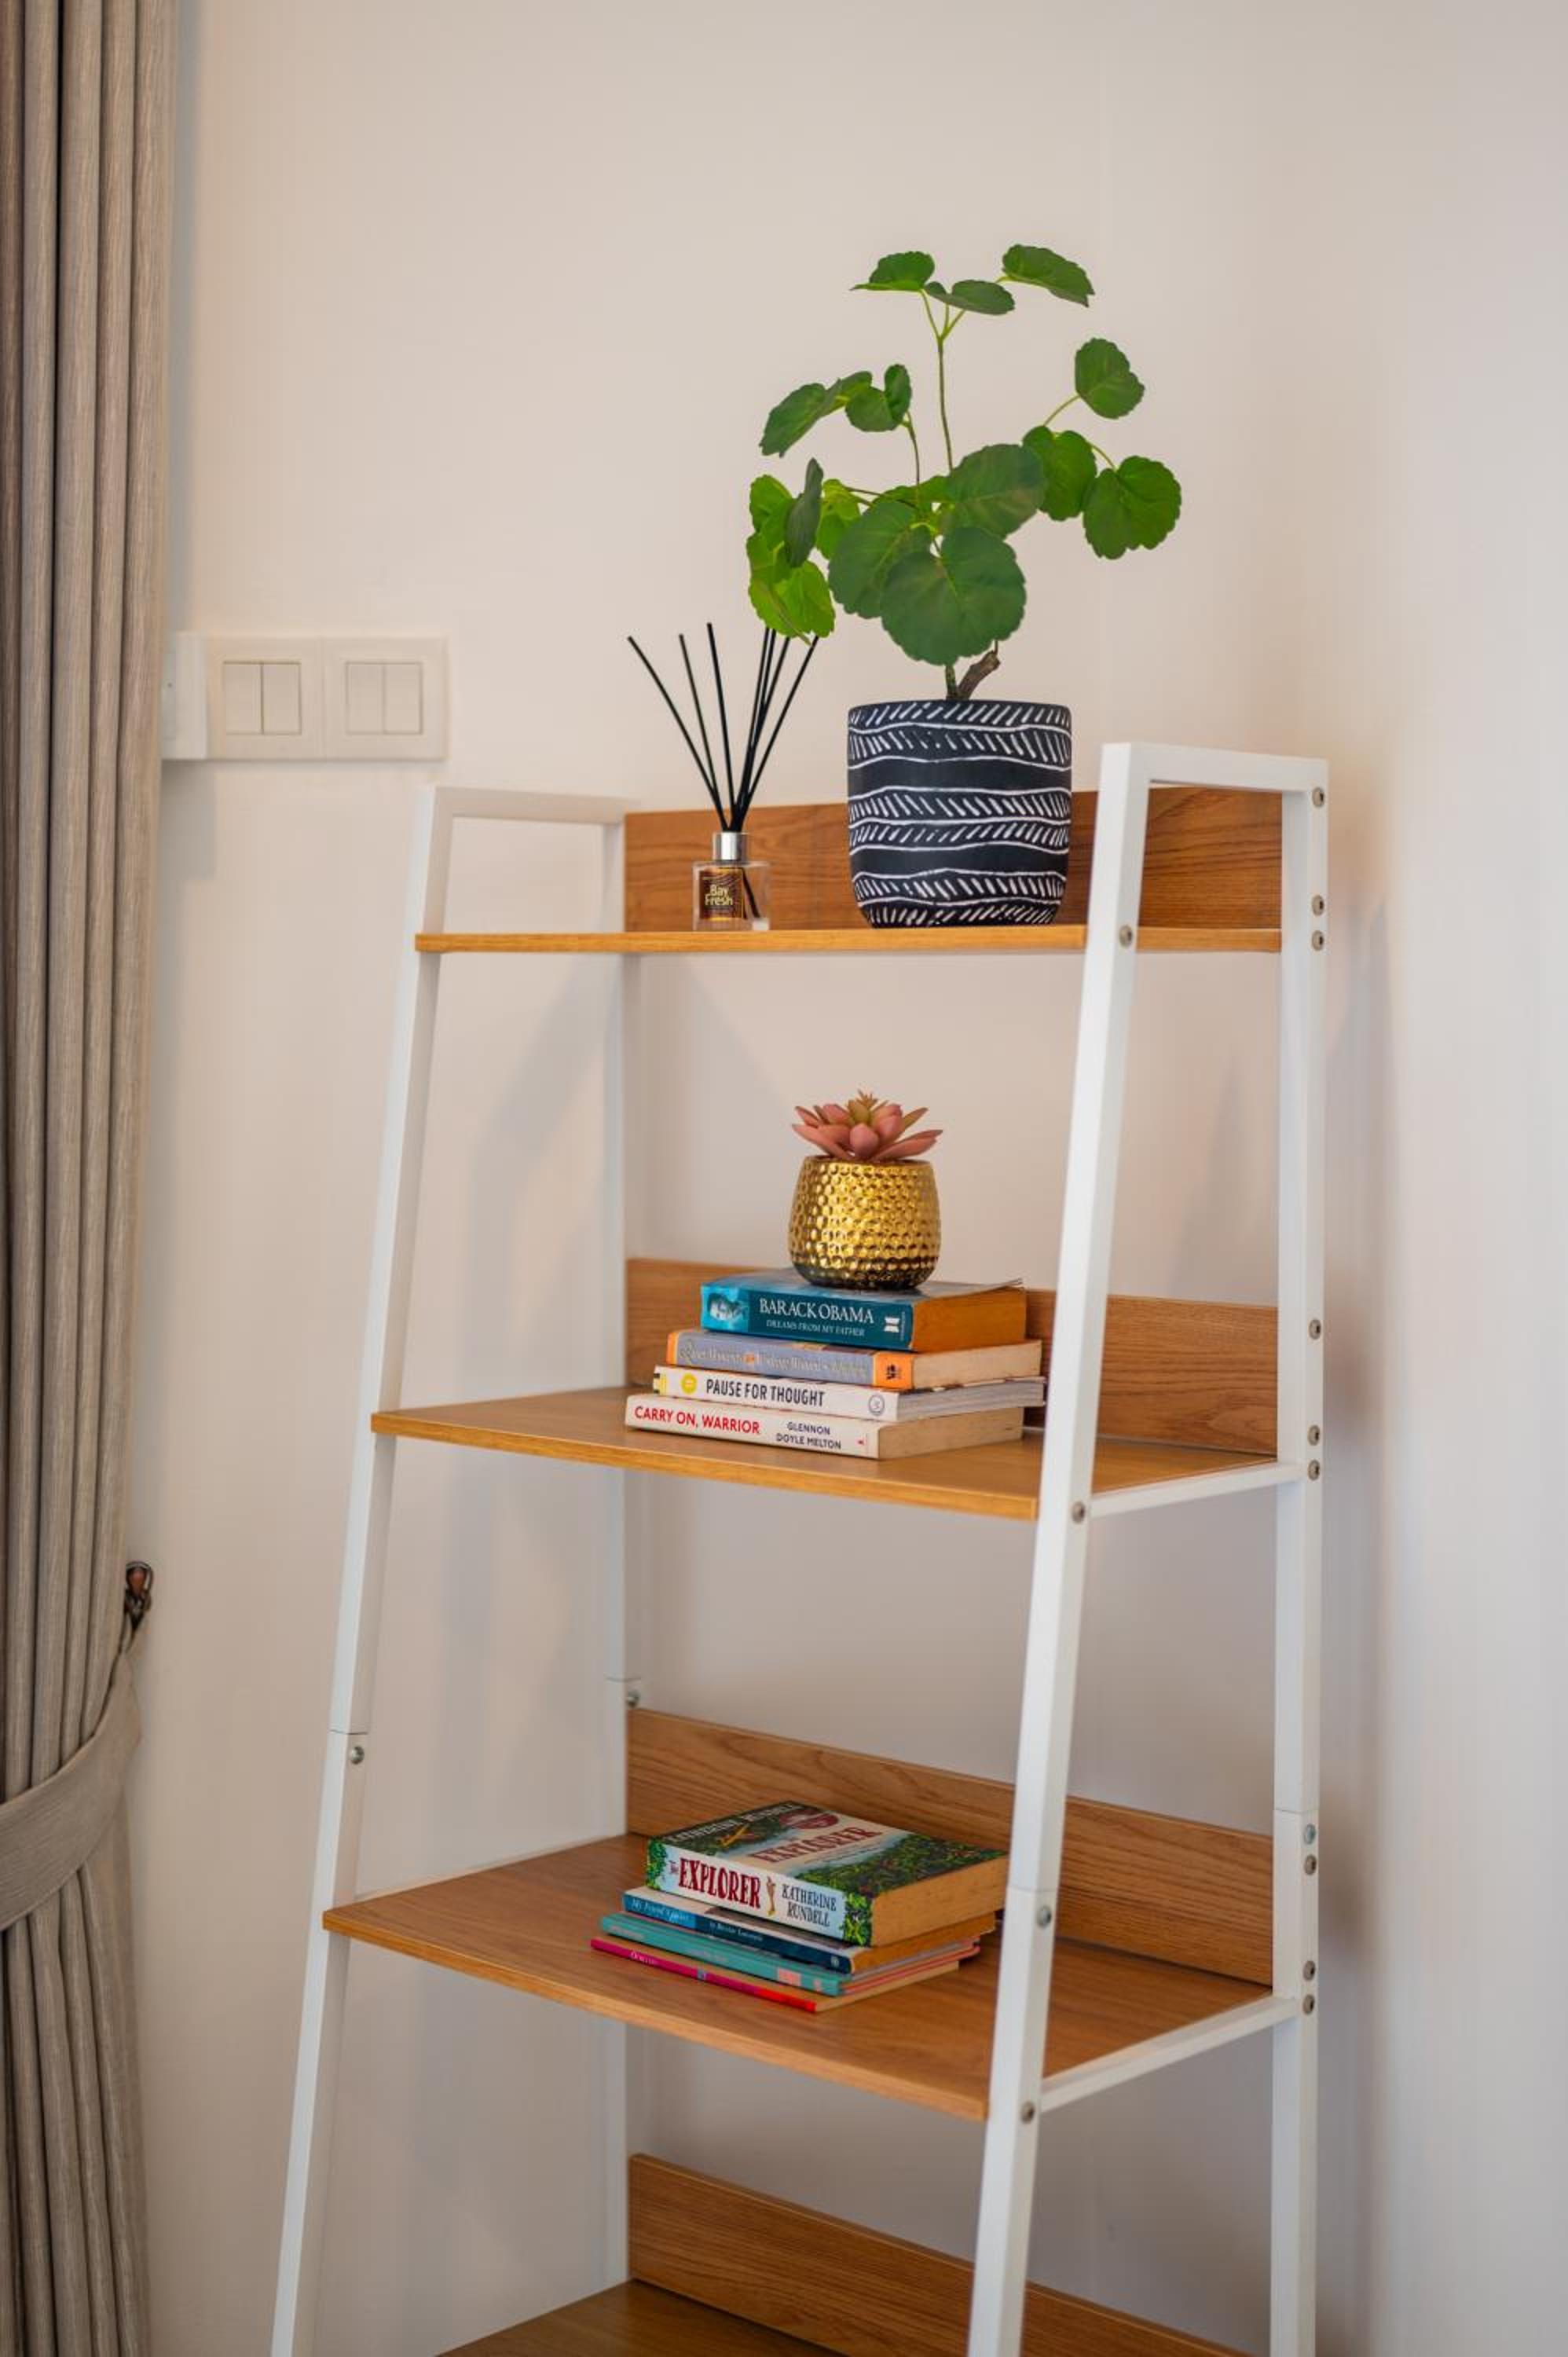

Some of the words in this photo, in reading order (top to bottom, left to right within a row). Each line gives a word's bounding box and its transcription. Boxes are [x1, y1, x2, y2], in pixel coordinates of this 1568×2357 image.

[705, 893, 733, 906] Fresh
[710, 884, 730, 897] Bay
[760, 1298, 818, 1319] BARACK
[819, 1303, 874, 1324] OBAMA
[766, 1319, 797, 1331] DREAMS
[798, 1322, 821, 1333] FROM
[822, 1325, 835, 1333] MY
[835, 1325, 865, 1336] FATHER
[706, 1379, 742, 1398] PAUSE
[745, 1383, 768, 1399] FOR
[771, 1385, 825, 1406] THOUGHT
[634, 1406, 674, 1422] CARRY
[676, 1412, 698, 1428] ON,
[702, 1413, 760, 1434] WARRIOR
[786, 1421, 830, 1435] GLENNON
[776, 1433, 805, 1446] DOYLE
[807, 1437, 841, 1450] MELTON
[678, 1857, 761, 1908] EXPLORER
[782, 1883, 837, 1912] KATHERINE
[787, 1901, 830, 1926] RUNDELL
